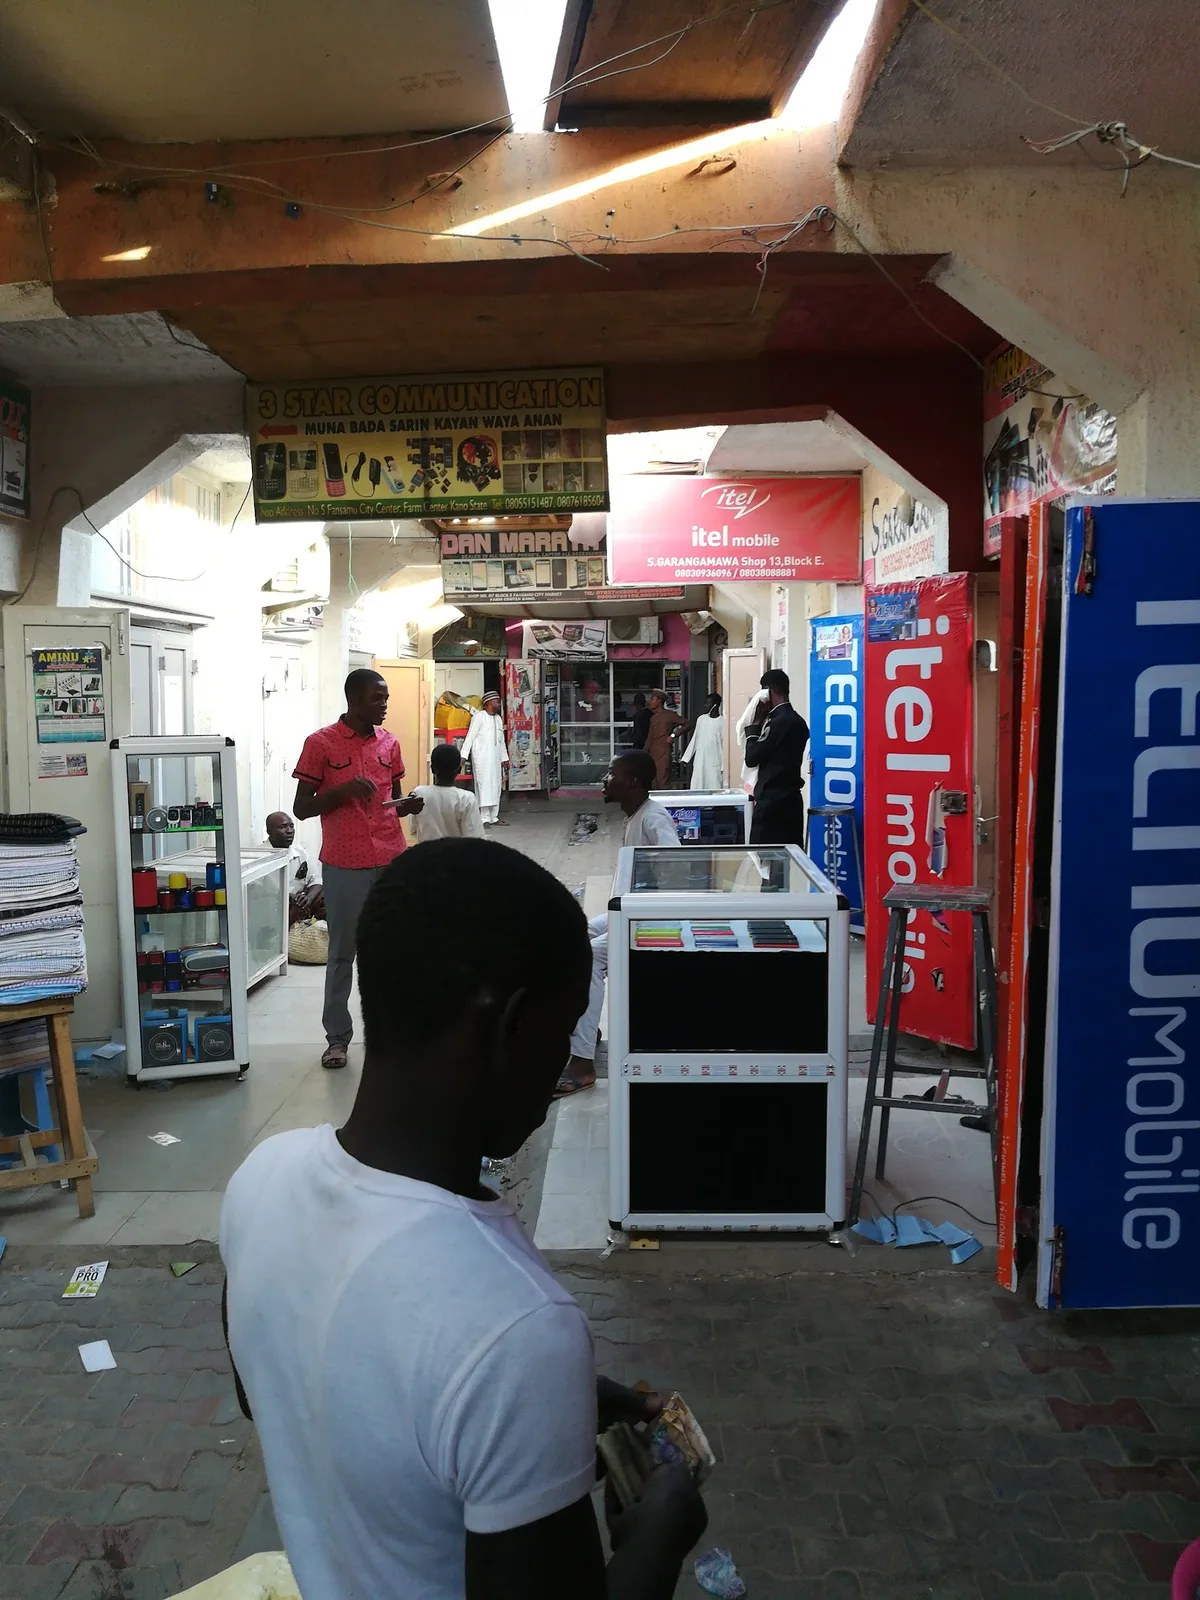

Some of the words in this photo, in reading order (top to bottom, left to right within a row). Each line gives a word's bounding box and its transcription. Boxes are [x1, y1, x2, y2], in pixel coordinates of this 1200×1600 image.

[258, 390, 278, 419] 3
[284, 386, 354, 418] STAR
[358, 377, 602, 416] COMMUNICATION
[304, 421, 346, 436] MUNA
[349, 420, 386, 434] BADA
[389, 418, 430, 432] SARIN
[434, 416, 480, 431] KAYAN
[482, 415, 521, 429] WAYA
[524, 414, 562, 428] ANAN
[308, 505, 319, 516] No
[360, 502, 374, 516] City
[404, 502, 422, 513] Farm
[424, 500, 448, 512] Center
[450, 500, 469, 511] Kano
[470, 500, 488, 511] State
[716, 488, 757, 506] itel
[441, 532, 492, 554] DAN
[691, 525, 728, 547] itel
[732, 534, 780, 547] mobile
[647, 557, 739, 567] S.GARANGAMAWA
[741, 557, 766, 568] Shop
[814, 556, 824, 565] E.
[675, 568, 731, 578] 08030936096
[38, 652, 79, 663] AMINU
[885, 614, 950, 772] itel
[824, 638, 858, 804] TECNO
[886, 794, 926, 994] moile
